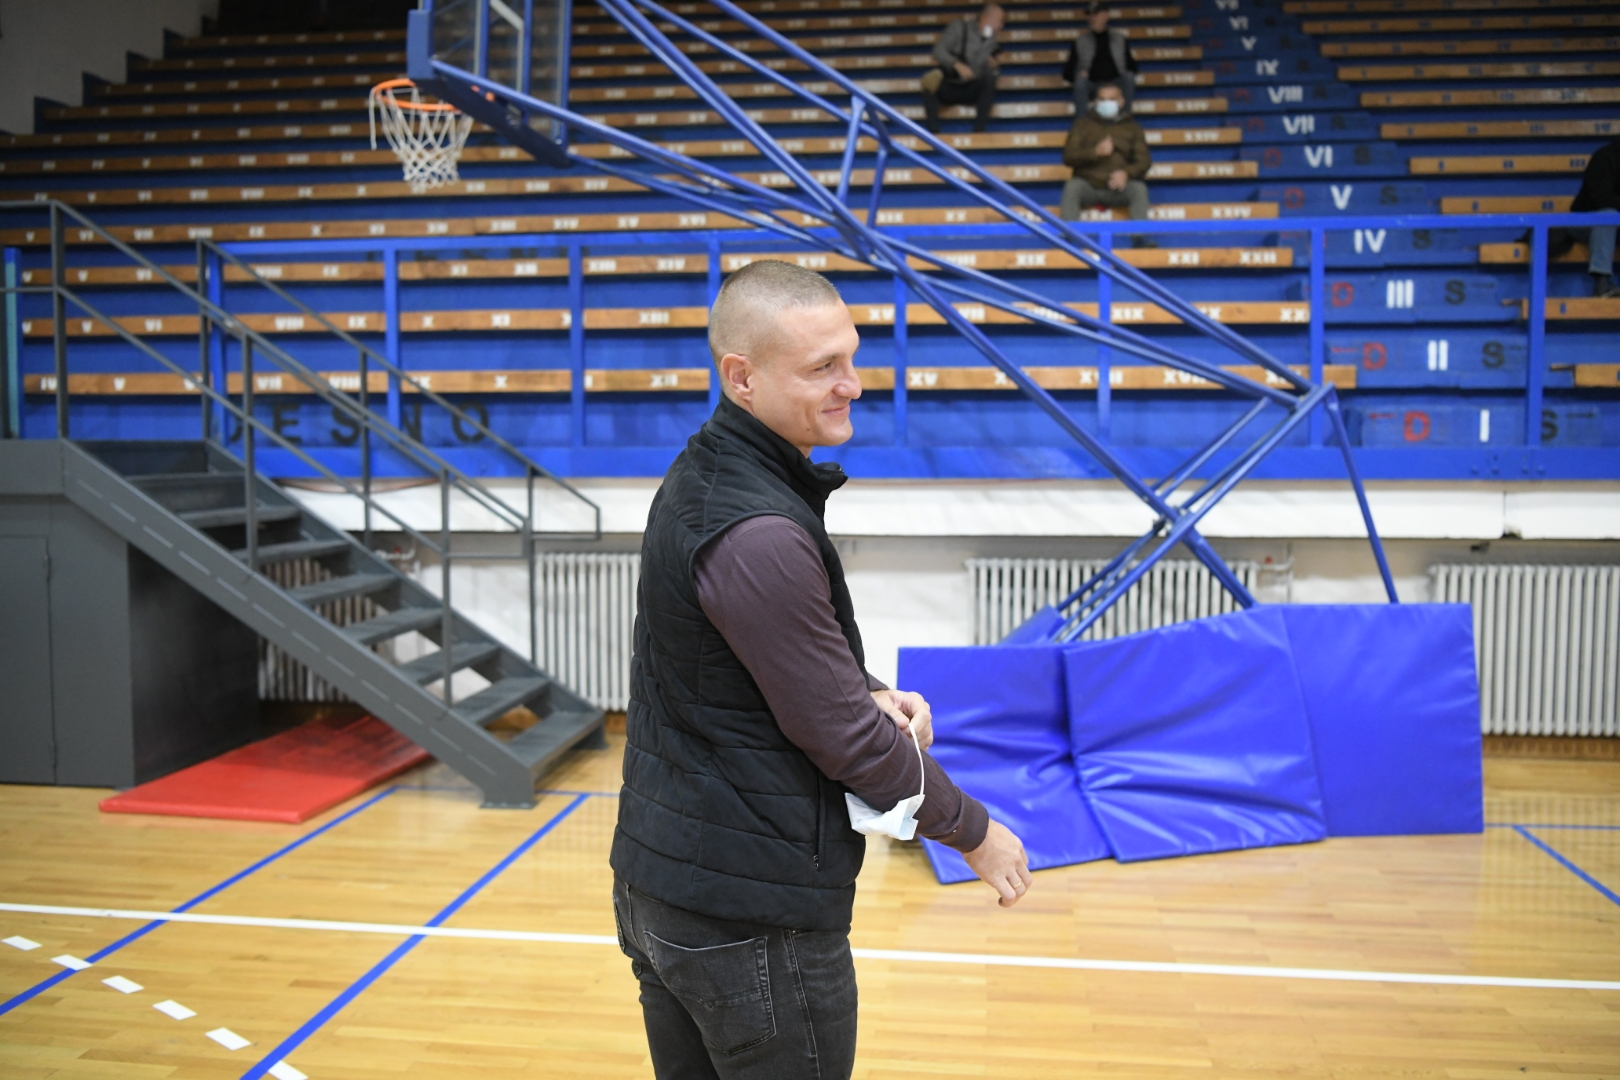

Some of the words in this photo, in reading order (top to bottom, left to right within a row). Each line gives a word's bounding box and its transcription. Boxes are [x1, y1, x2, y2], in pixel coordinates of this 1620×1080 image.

[1267, 85, 1304, 105] VIII
[1282, 114, 1316, 135] VII
[1303, 144, 1334, 169] VI
[1330, 184, 1353, 210] V
[1354, 229, 1386, 253] IV
[1017, 254, 1045, 266] XIX
[1169, 252, 1199, 264] XXI
[1241, 251, 1277, 263] XXII
[1332, 281, 1354, 307] D
[1386, 279, 1415, 310] III
[1445, 279, 1466, 305] S
[639, 311, 668, 324] XIII
[1111, 306, 1143, 320] XIX
[1362, 342, 1388, 371] D
[1427, 340, 1449, 371] II
[1482, 341, 1505, 369] S
[651, 373, 678, 387] XII
[910, 372, 937, 385] XV
[1403, 411, 1431, 443] D
[1479, 408, 1490, 443] I
